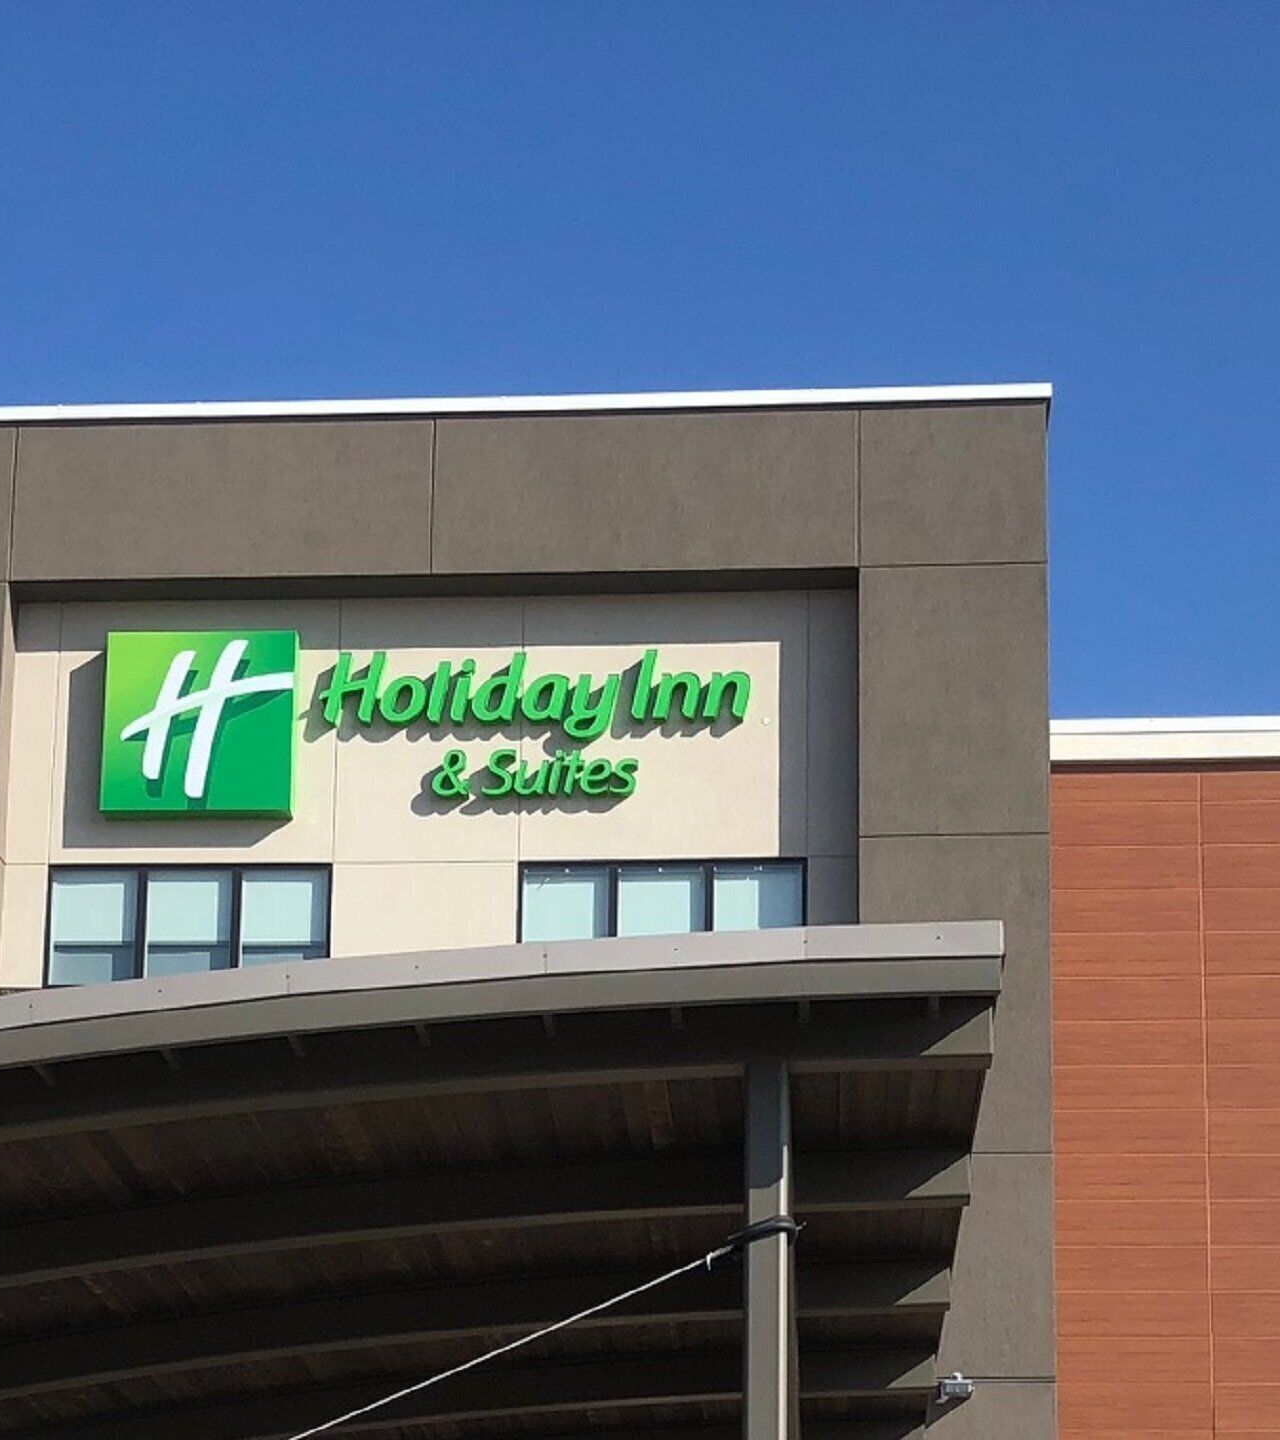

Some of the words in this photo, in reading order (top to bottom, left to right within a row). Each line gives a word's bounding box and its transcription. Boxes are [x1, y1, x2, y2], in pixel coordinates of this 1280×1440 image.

[319, 650, 620, 740] Holiday
[630, 649, 751, 723] Inn
[430, 748, 471, 800] &
[481, 748, 639, 797] Suites
